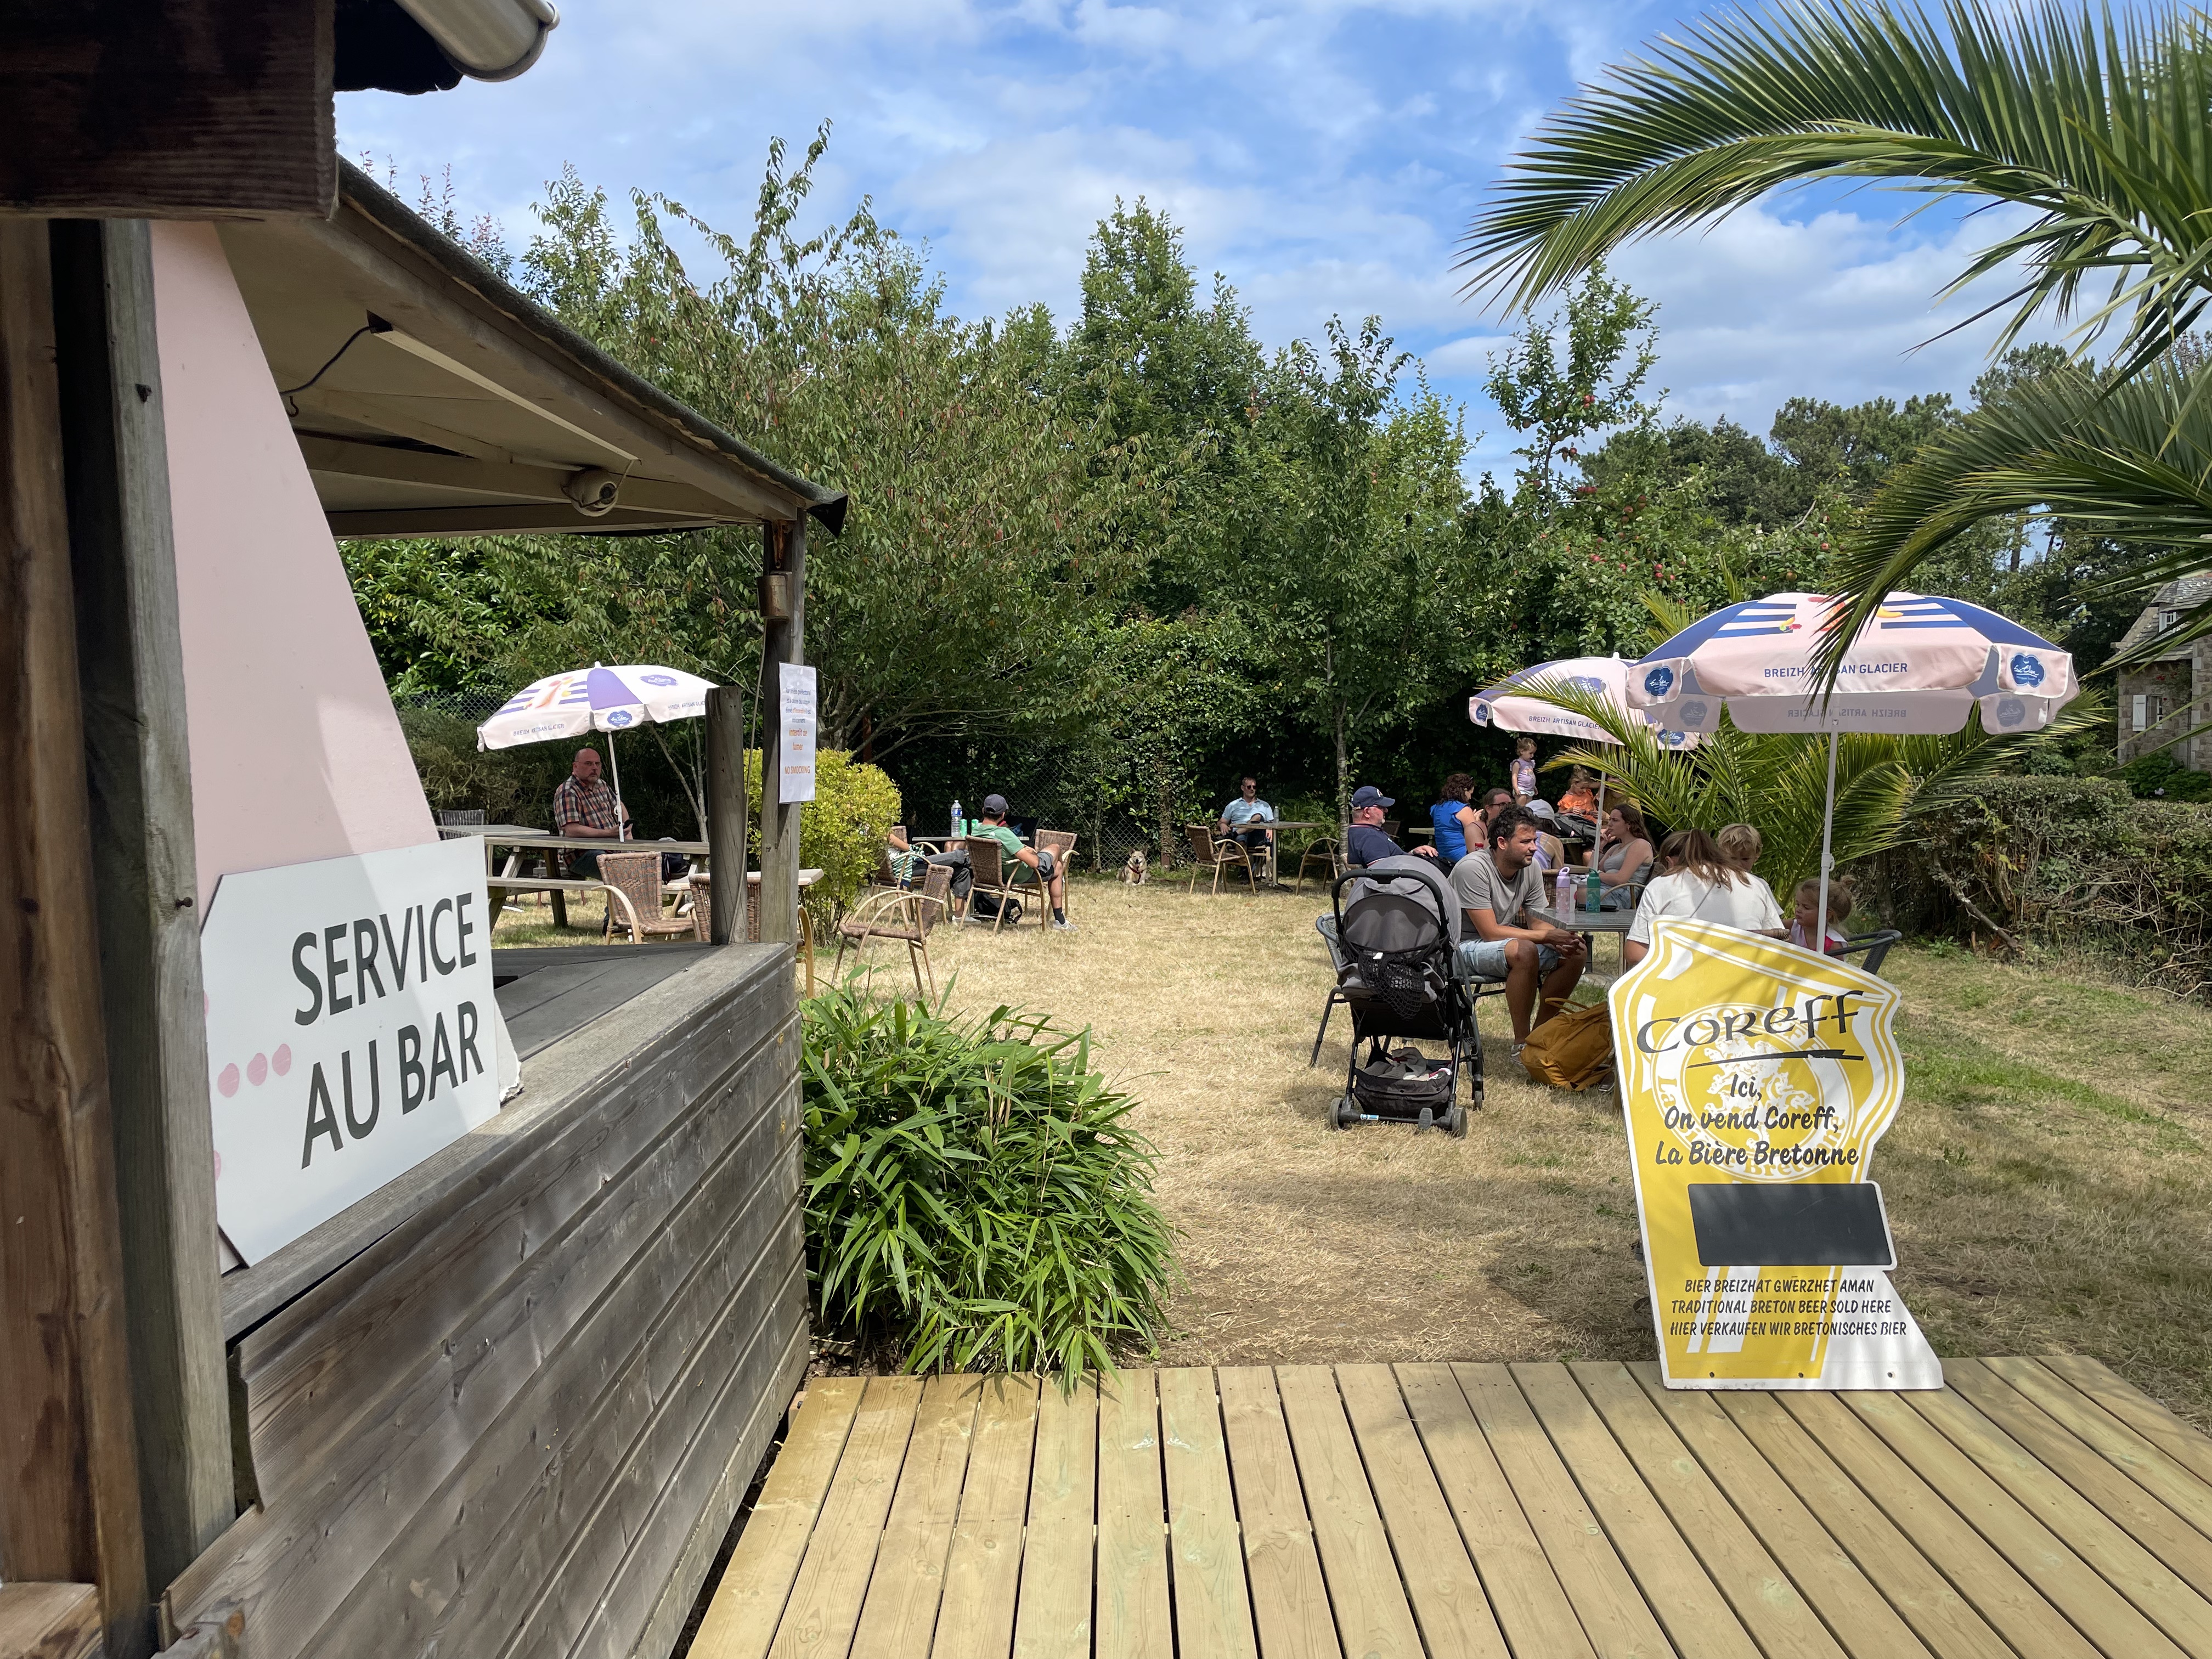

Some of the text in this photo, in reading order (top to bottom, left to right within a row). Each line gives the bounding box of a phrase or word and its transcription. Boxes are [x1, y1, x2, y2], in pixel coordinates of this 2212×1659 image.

[1764, 667, 1805, 678] BREIZH
[1859, 663, 1908, 674] GLACIER
[785, 766, 810, 774] NO SMOCKING
[291, 892, 476, 1026] SERVICE
[301, 1001, 484, 1170] AU BAR
[1730, 1074, 1762, 1101] Ici,
[1664, 1105, 1839, 1133] On vend Coreff,
[1655, 1140, 1683, 1165] La
[1689, 1140, 1748, 1165] Bière
[1754, 1141, 1859, 1165] Bretonne
[1685, 1279, 1711, 1292] BIER
[1714, 1279, 1772, 1293] BREIZHAT
[1839, 1279, 1874, 1293] AMAN
[1672, 1300, 1891, 1313] TRADITIONAL BRETON BEER SOLD HERE
[1670, 1322, 1906, 1335] HIER VERKAUFEN WIR BRETONISCHES BIER
